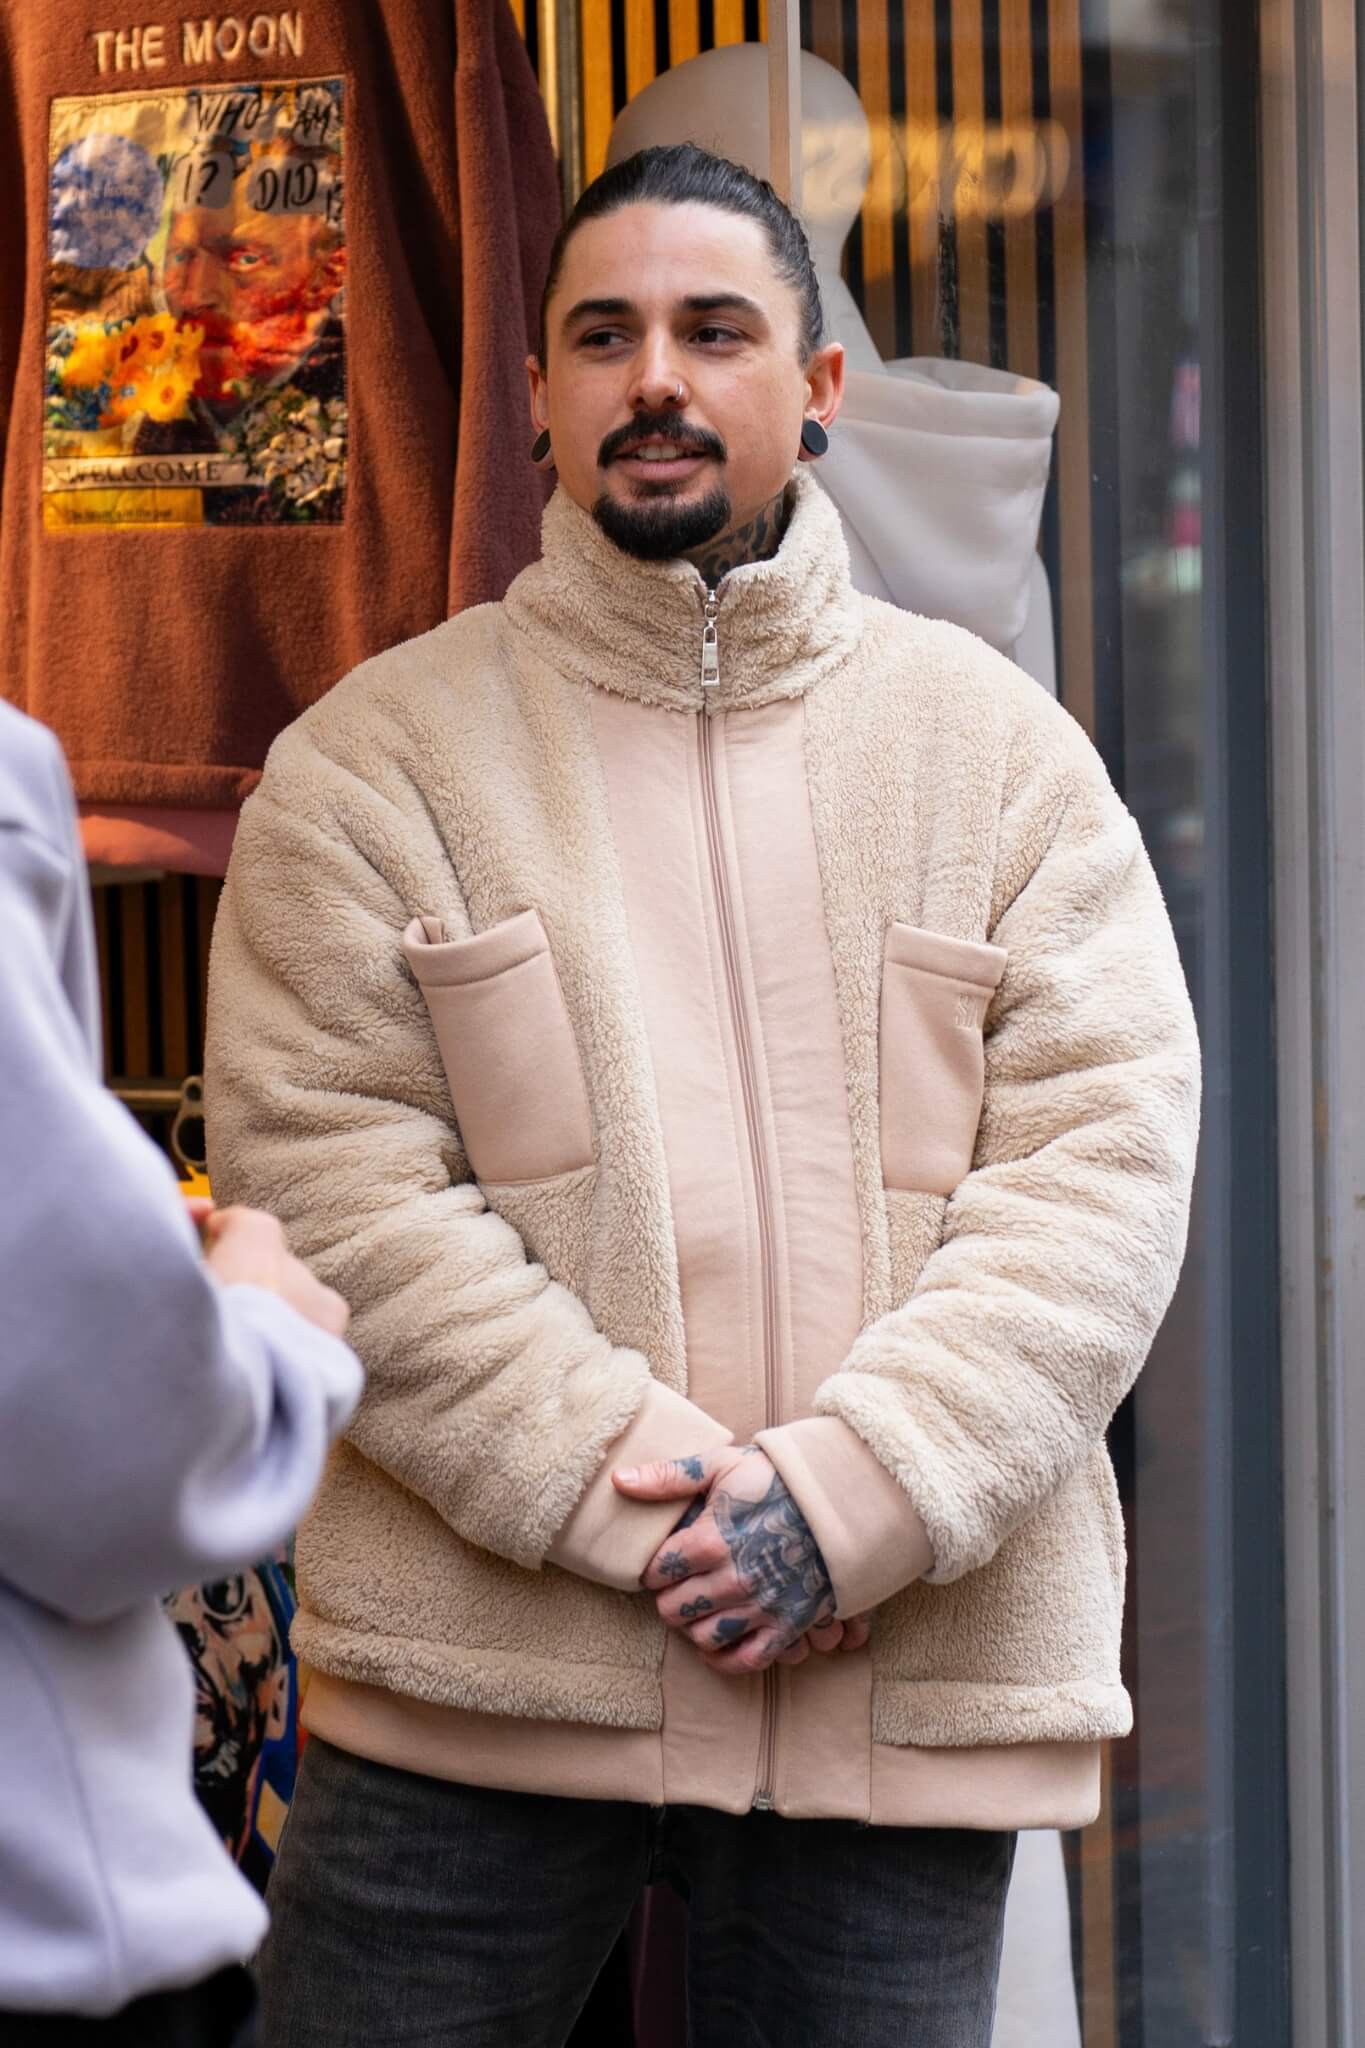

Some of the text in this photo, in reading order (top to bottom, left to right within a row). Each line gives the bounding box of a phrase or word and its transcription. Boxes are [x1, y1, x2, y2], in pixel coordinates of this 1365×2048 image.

[94, 12, 304, 73] THE MOON
[197, 92, 332, 143] WHO AM
[254, 162, 318, 211] DID
